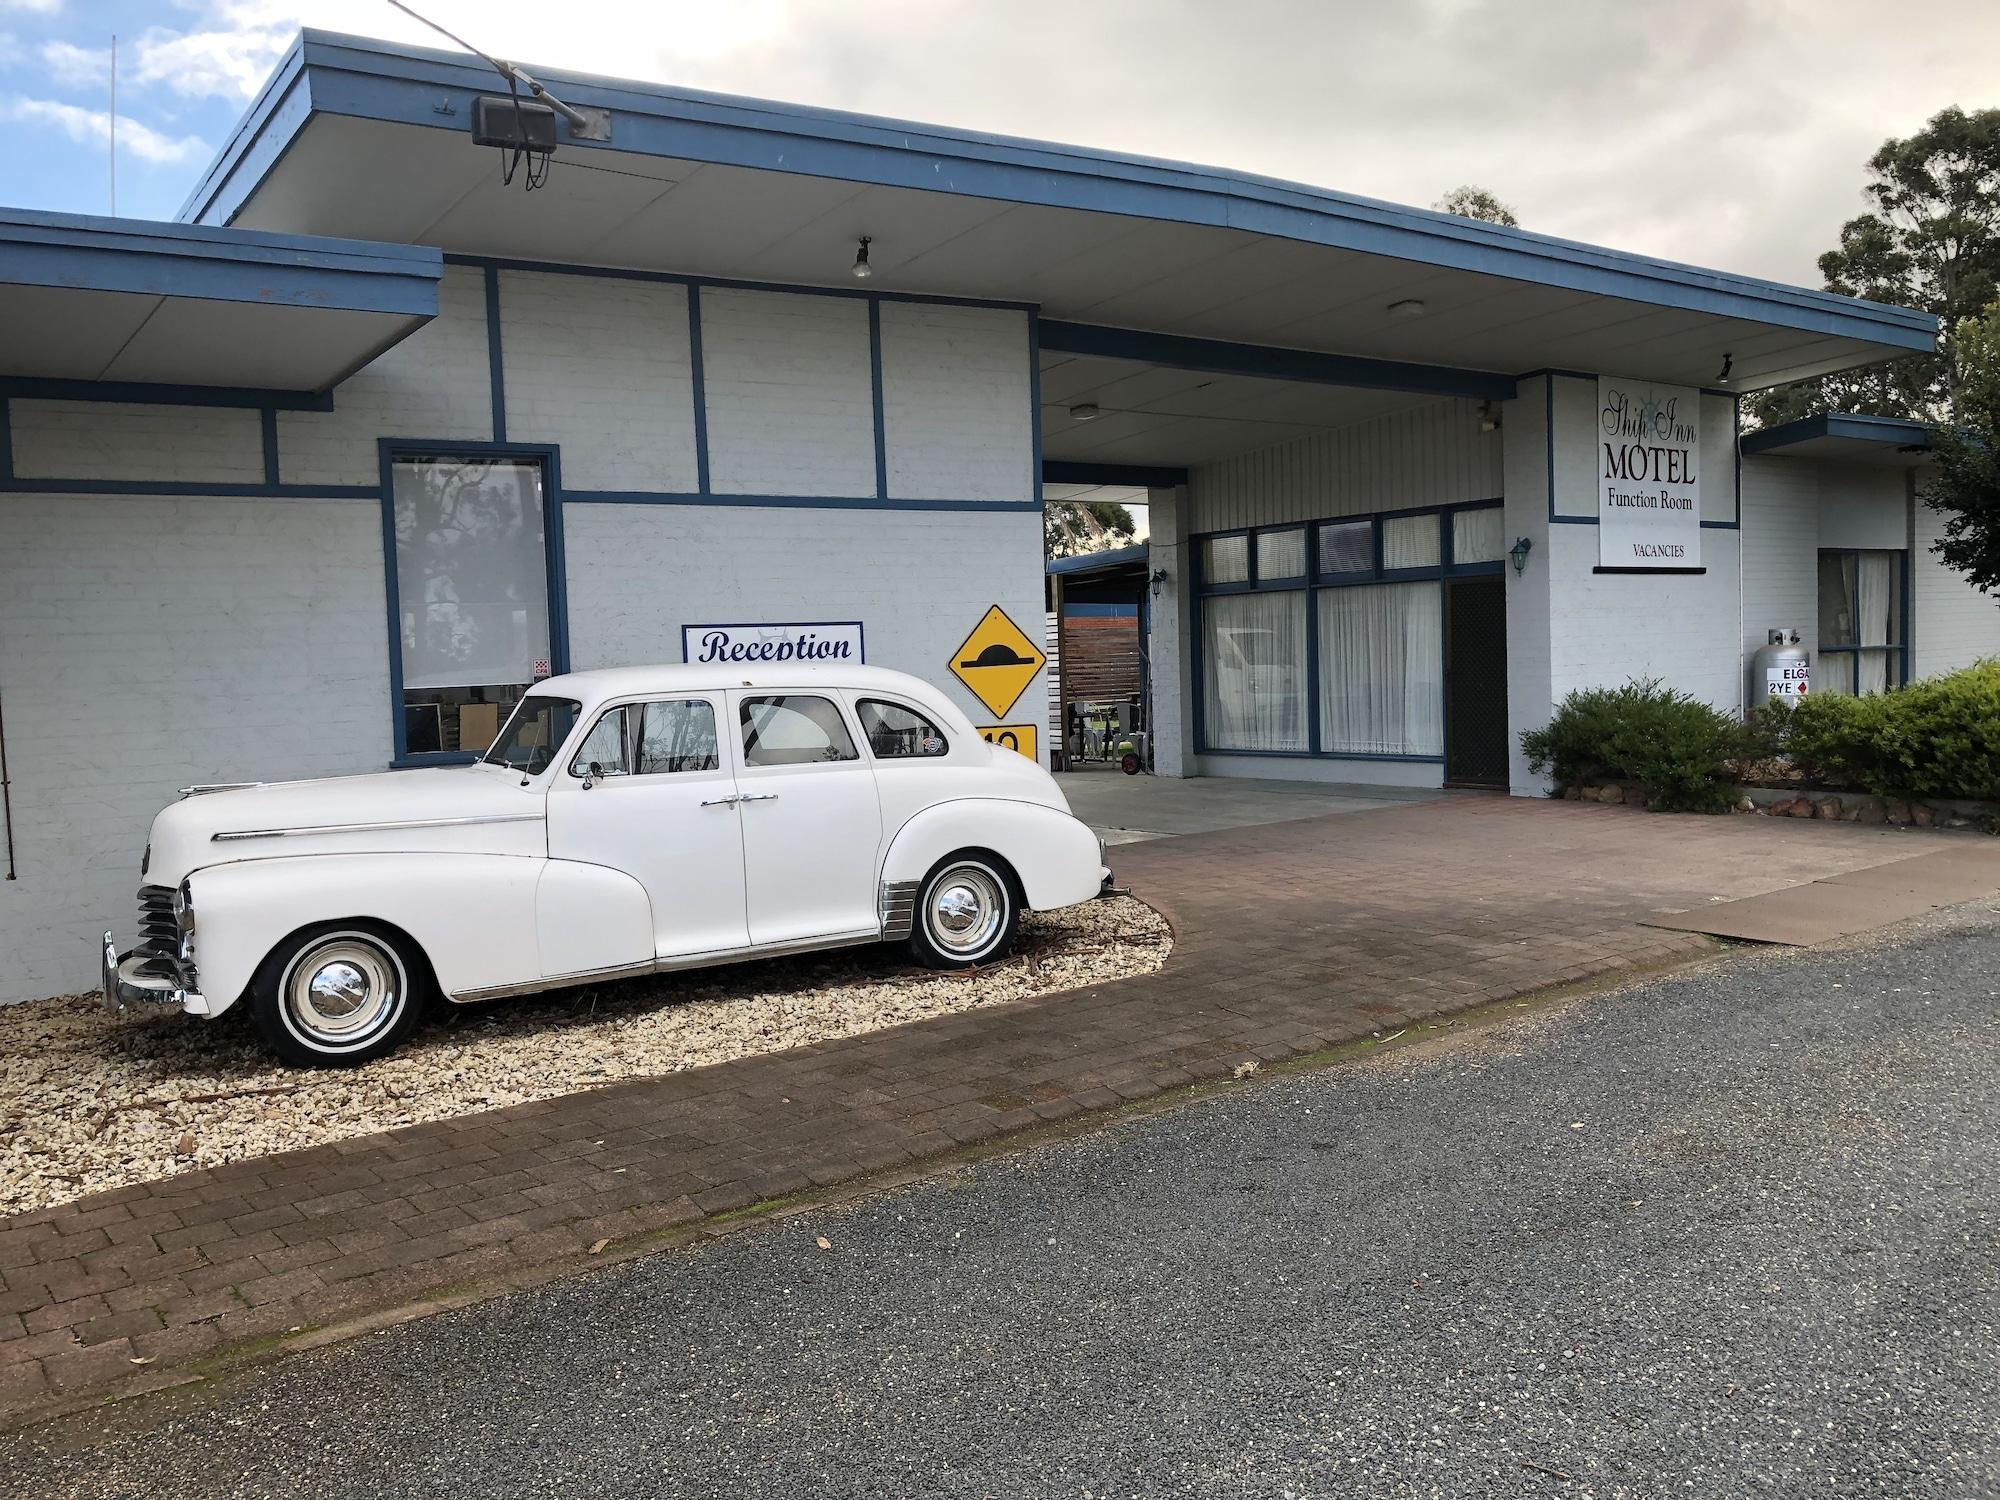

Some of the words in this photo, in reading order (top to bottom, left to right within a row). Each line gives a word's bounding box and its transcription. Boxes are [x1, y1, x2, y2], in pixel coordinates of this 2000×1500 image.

[1602, 389, 1649, 453] Ship
[1655, 397, 1696, 443] Inn
[1604, 443, 1696, 485] MOTEL
[1608, 487, 1658, 509] Function
[1660, 490, 1693, 511] Room
[1633, 543, 1685, 558] VACANCIES
[698, 631, 852, 663] Reception
[1769, 682, 1792, 694] 2YE
